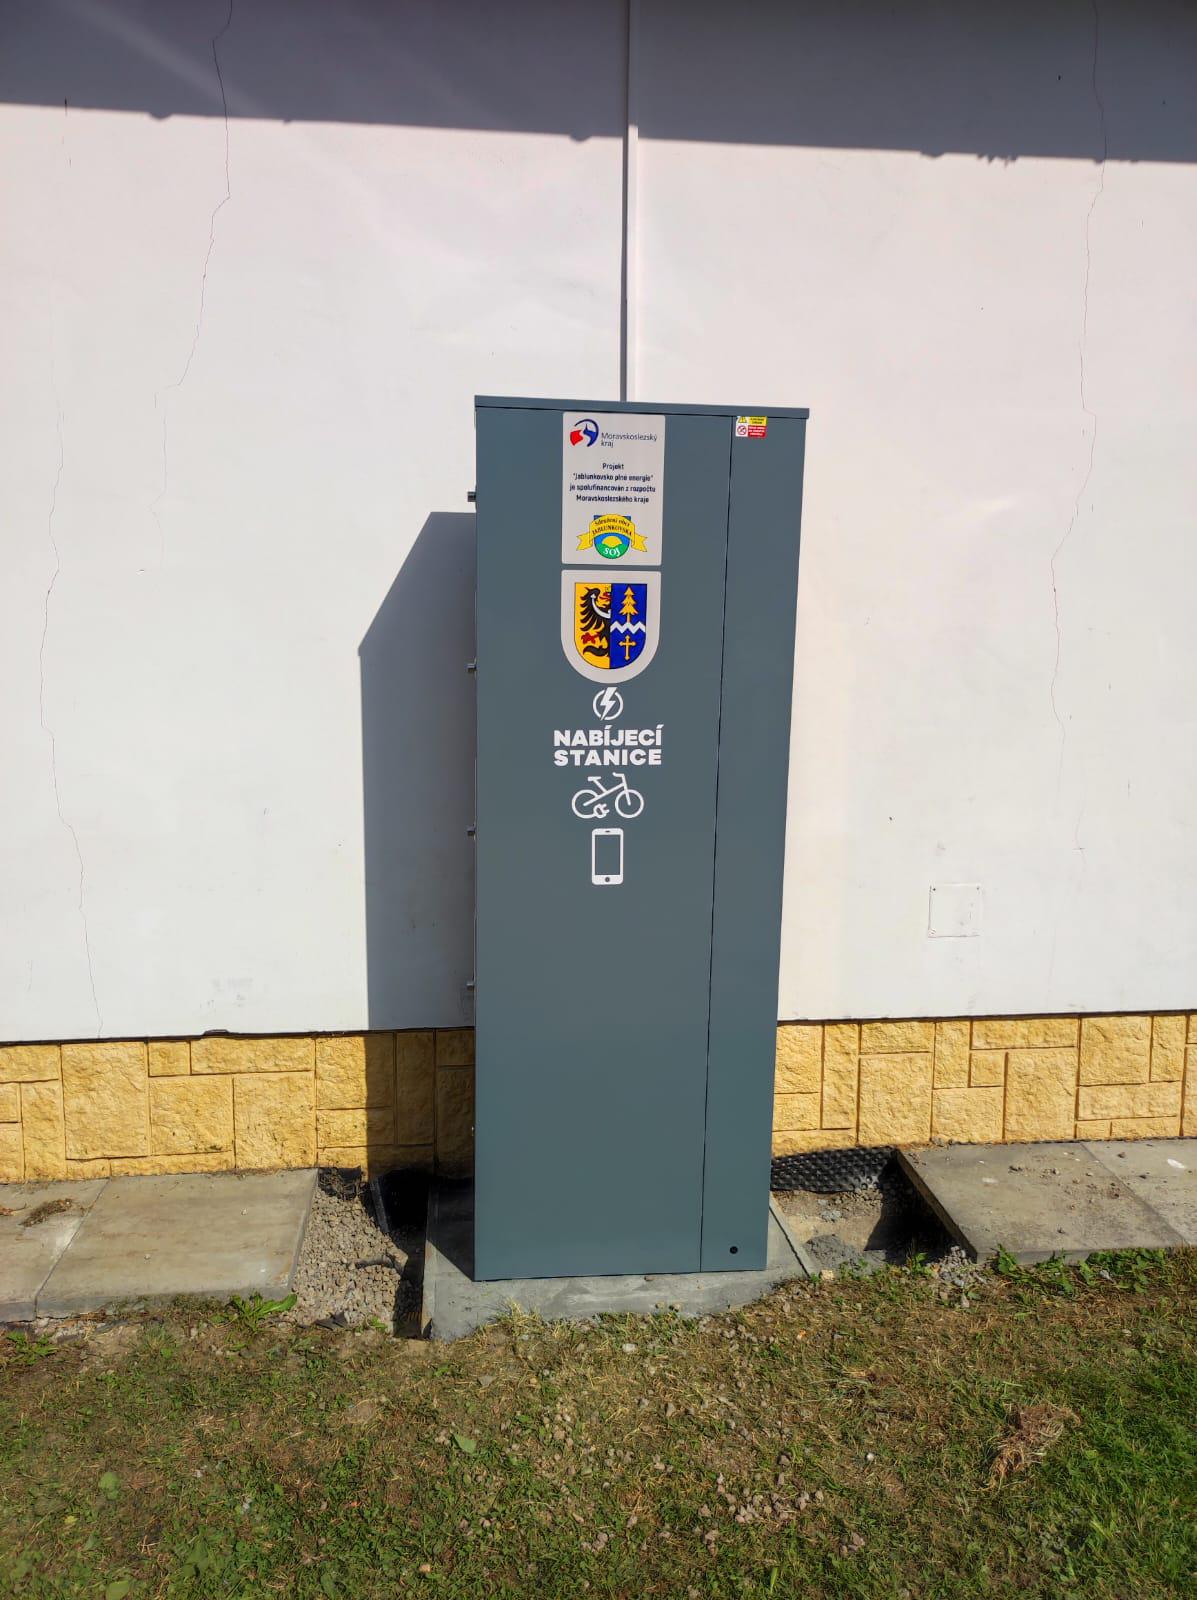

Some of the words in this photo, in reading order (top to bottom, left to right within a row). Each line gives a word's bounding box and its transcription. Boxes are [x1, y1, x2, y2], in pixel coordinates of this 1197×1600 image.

[601, 432, 658, 442] Moravskoslezský
[601, 440, 614, 448] kraj
[602, 463, 625, 471] Projekt
[577, 484, 624, 492] spolufinancován
[630, 485, 656, 493] rozpočtu
[576, 495, 633, 503] Moravskoslezského
[634, 496, 649, 504] kraje
[603, 547, 621, 557] SOJ
[553, 724, 664, 747] NABÍJECÍ
[553, 748, 662, 767] STANICE
